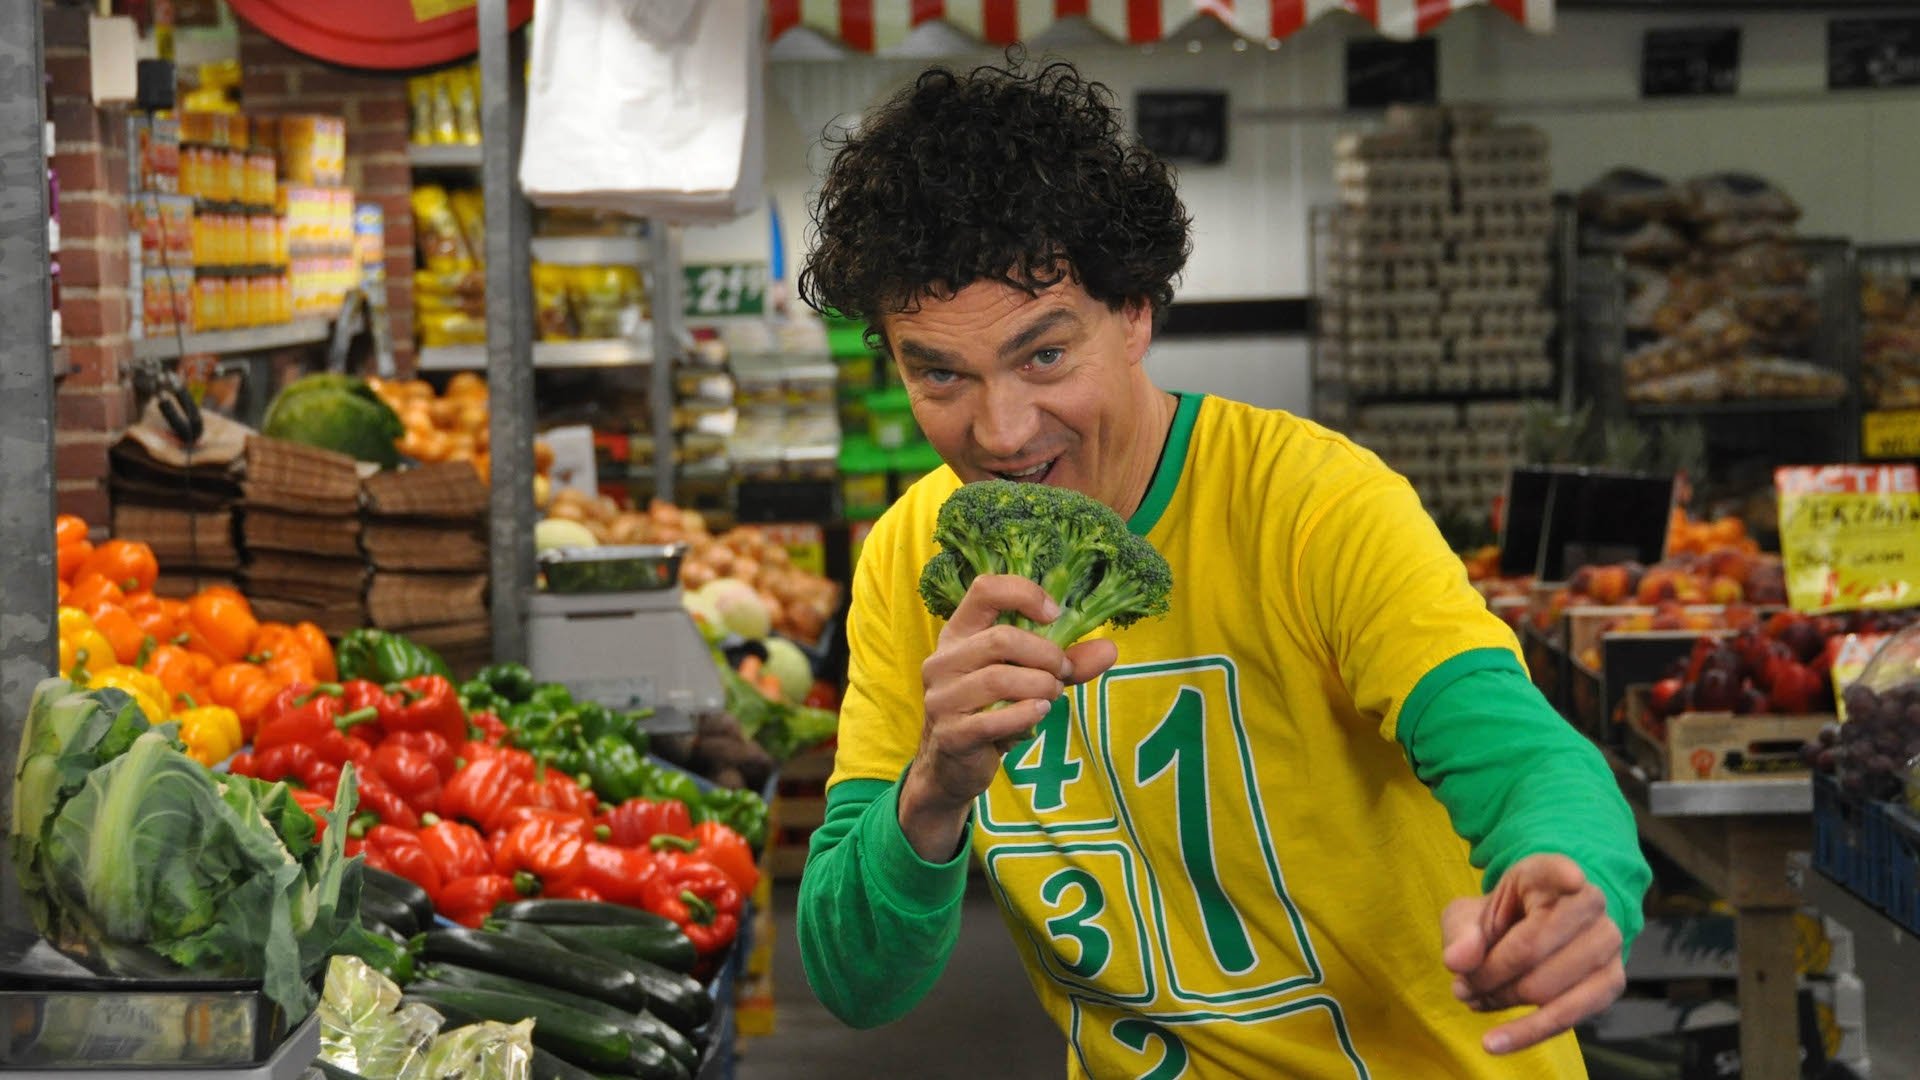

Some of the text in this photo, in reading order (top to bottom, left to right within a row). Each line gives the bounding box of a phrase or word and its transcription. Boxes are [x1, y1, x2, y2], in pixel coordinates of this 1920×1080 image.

[1002, 692, 1083, 814] 4
[1134, 684, 1260, 976] 1
[1041, 866, 1112, 980] 3
[1111, 1017, 1190, 1080] 2
